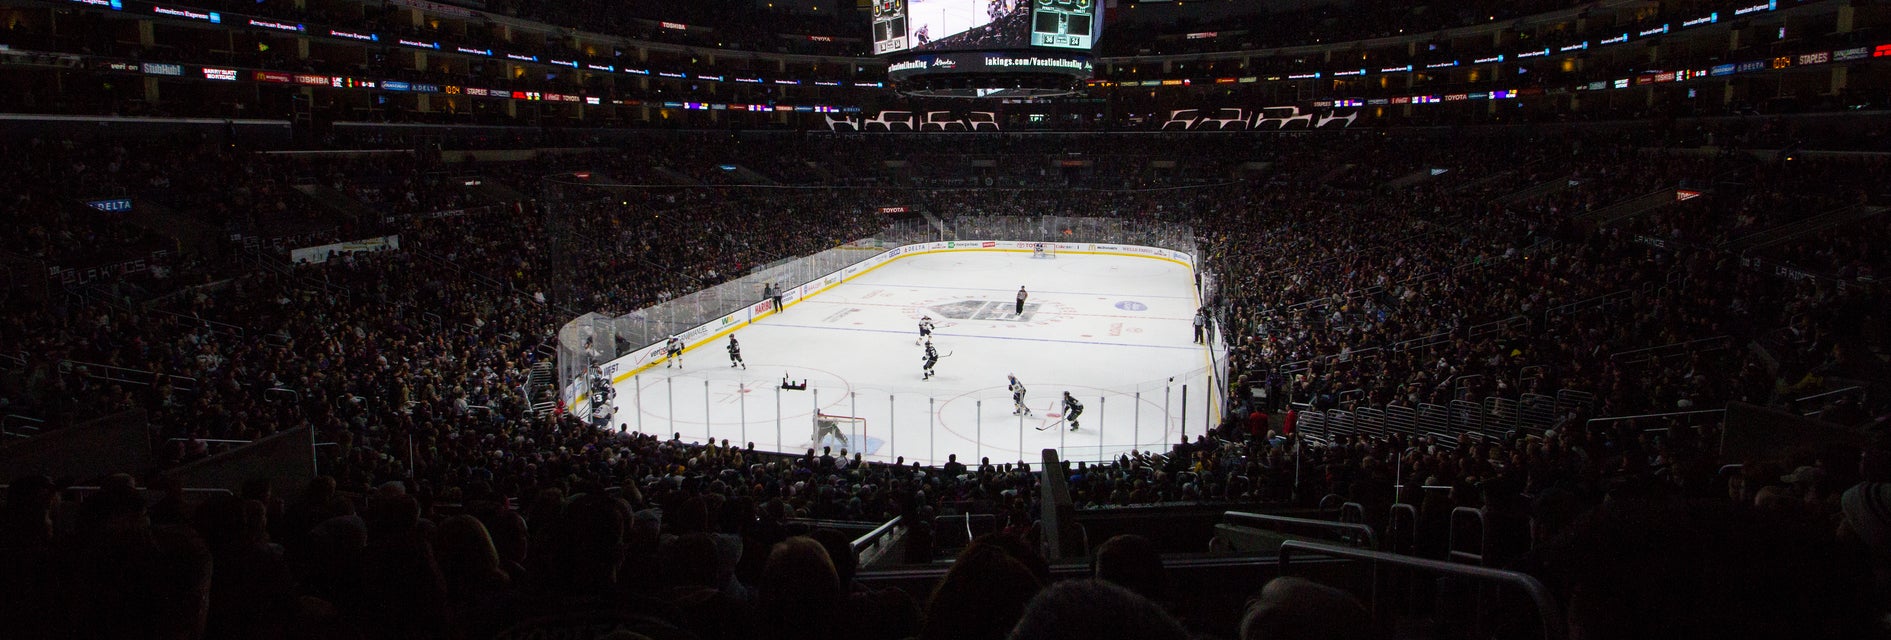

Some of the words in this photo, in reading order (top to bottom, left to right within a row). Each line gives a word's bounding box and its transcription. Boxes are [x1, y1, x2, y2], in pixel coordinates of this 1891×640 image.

[154, 7, 184, 16] American
[184, 11, 209, 19] Express
[249, 19, 276, 28] American
[276, 23, 297, 31] Express
[662, 22, 686, 30] TOSHIBA
[1799, 52, 1828, 65] STAPLES
[144, 63, 181, 76] StubHub!
[1743, 61, 1764, 71] DELTA
[294, 75, 330, 85] TOSHIBA
[418, 84, 438, 92] DELTA
[466, 87, 488, 96] STAPLES
[97, 200, 131, 211] DELTA
[908, 244, 925, 252] DELTA
[754, 299, 773, 315] HARIBO
